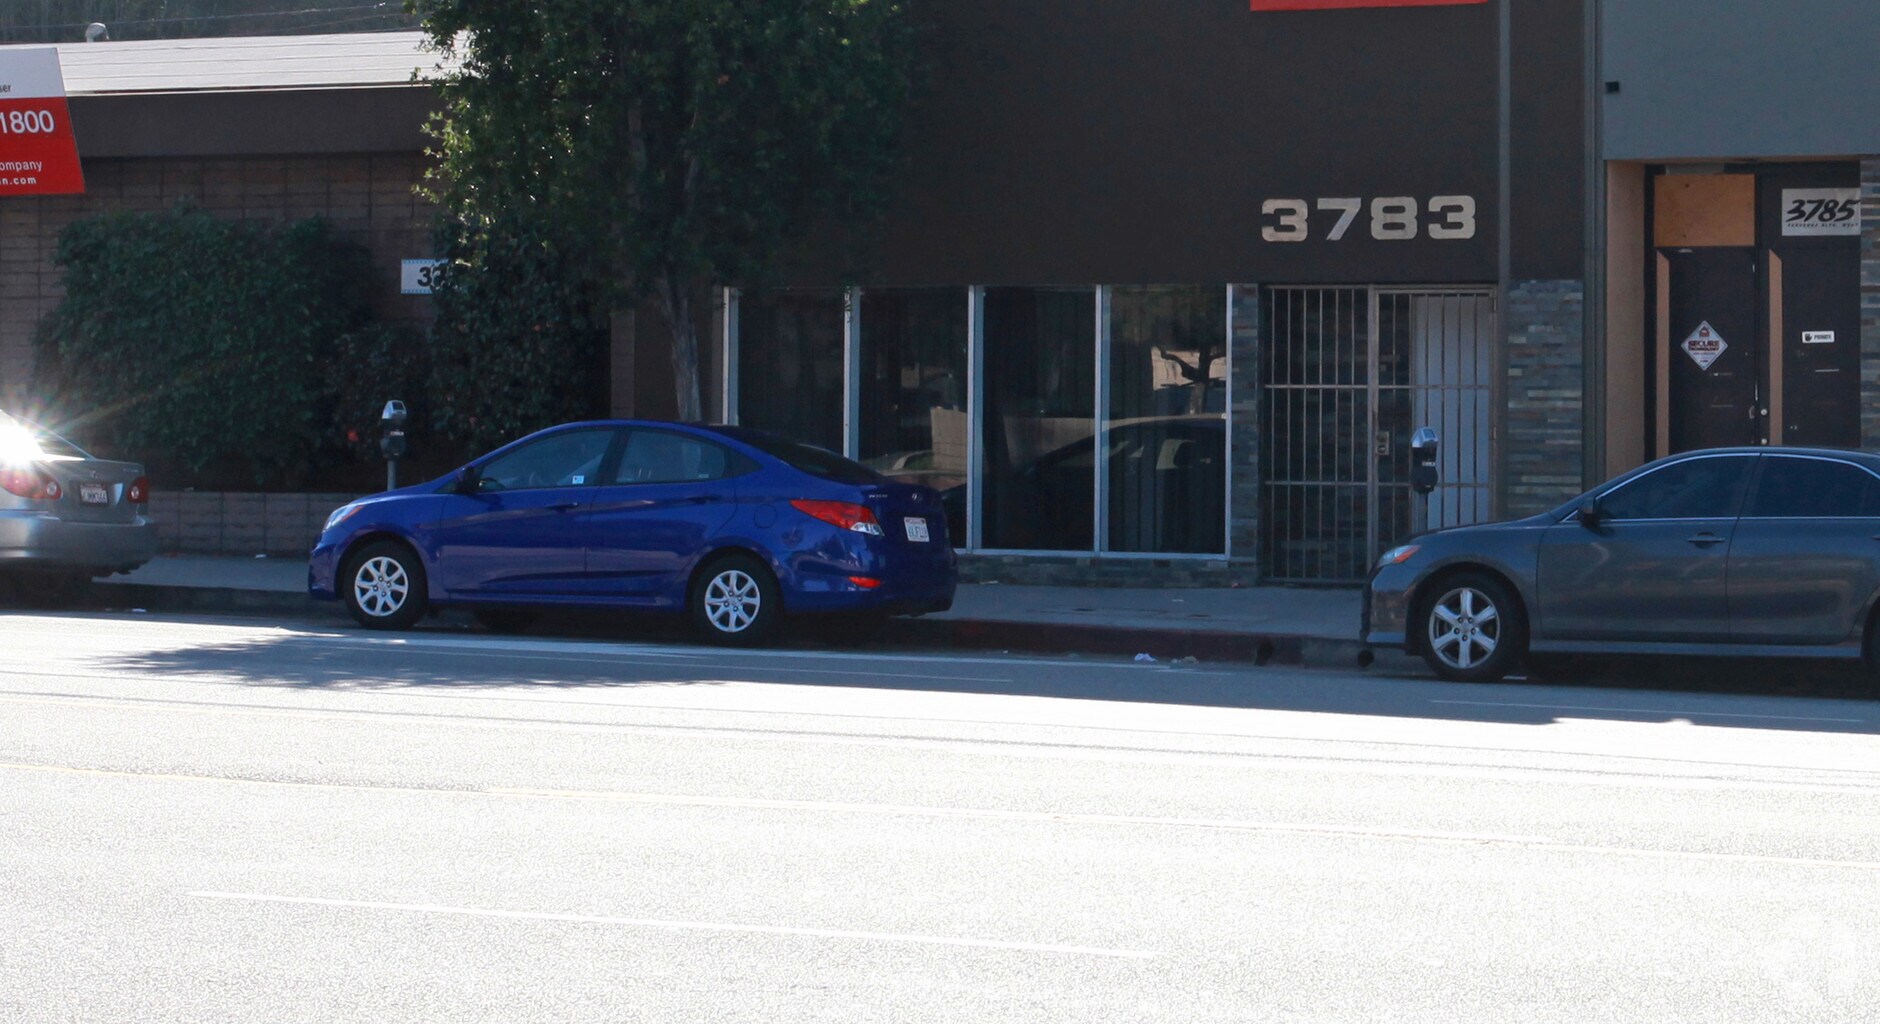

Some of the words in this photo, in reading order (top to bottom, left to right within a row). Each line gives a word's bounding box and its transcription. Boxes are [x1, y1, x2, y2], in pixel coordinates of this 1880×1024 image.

[0, 110, 54, 134] 1800
[0, 177, 37, 185] n.com
[1261, 195, 1476, 242] 3783
[1786, 199, 1861, 222] 3785
